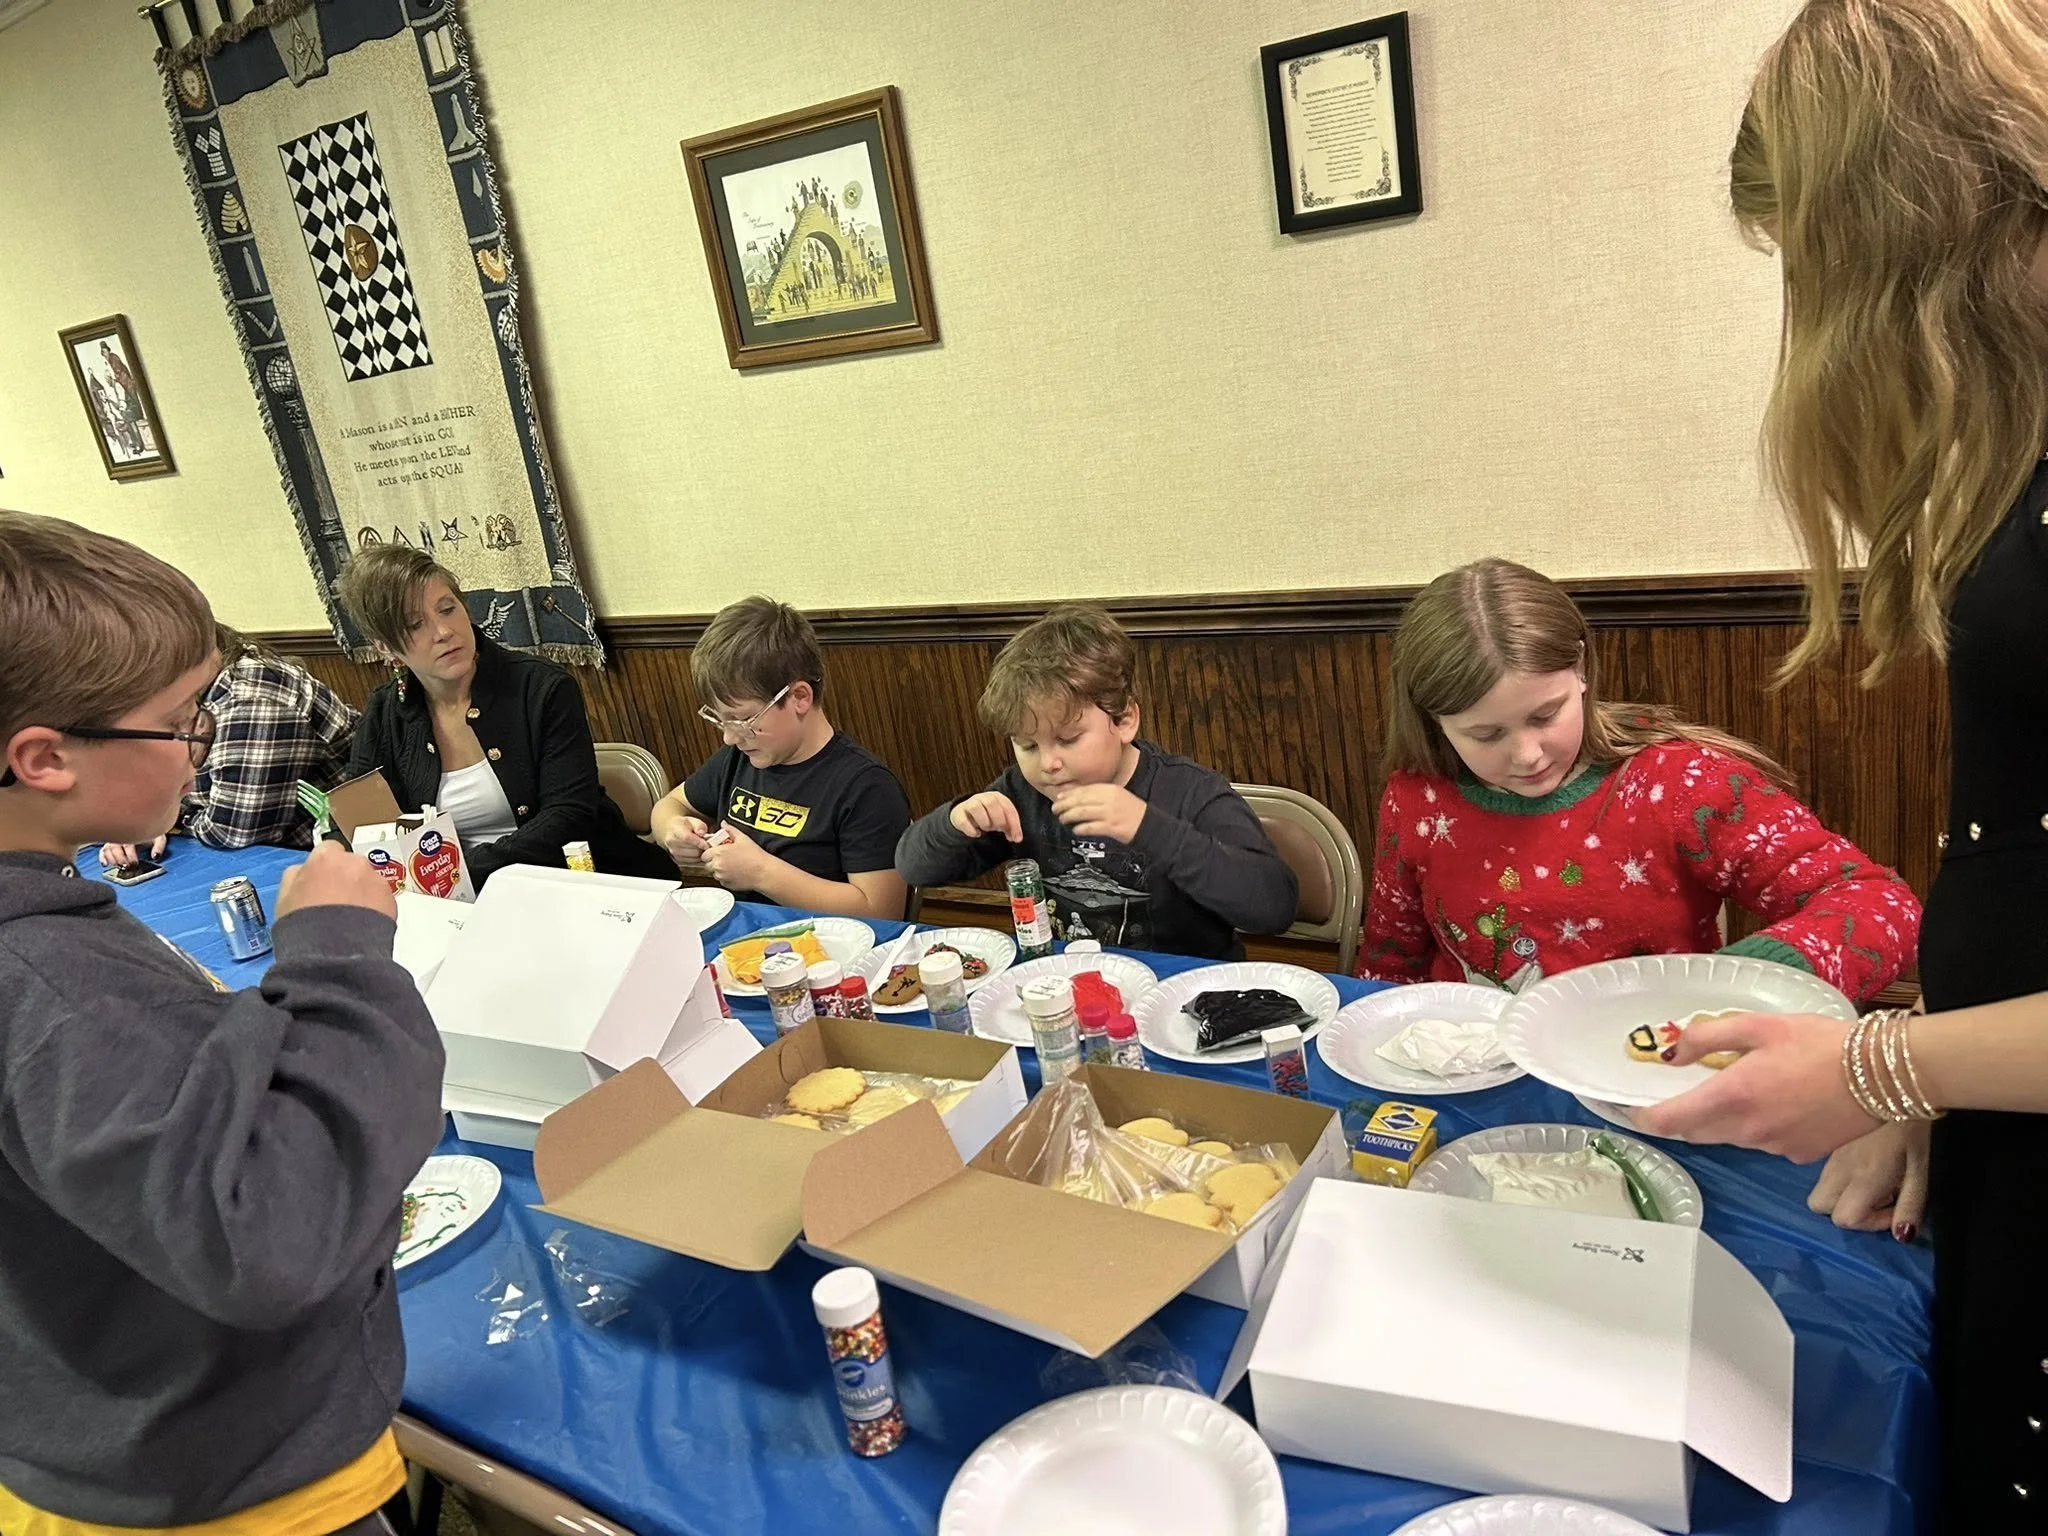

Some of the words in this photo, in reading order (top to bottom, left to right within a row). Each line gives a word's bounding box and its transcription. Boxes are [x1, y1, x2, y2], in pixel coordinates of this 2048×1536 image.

[378, 421, 388, 432] is
[411, 411, 431, 425] and
[413, 433, 423, 444] is
[424, 431, 436, 442] in
[354, 461, 368, 472] He
[369, 458, 399, 470] meets
[420, 450, 438, 461] the
[377, 476, 398, 487] acts
[420, 833, 440, 850] Great
[419, 851, 452, 877] Everyday
[1362, 1133, 1416, 1152] TOOTHPICKS
